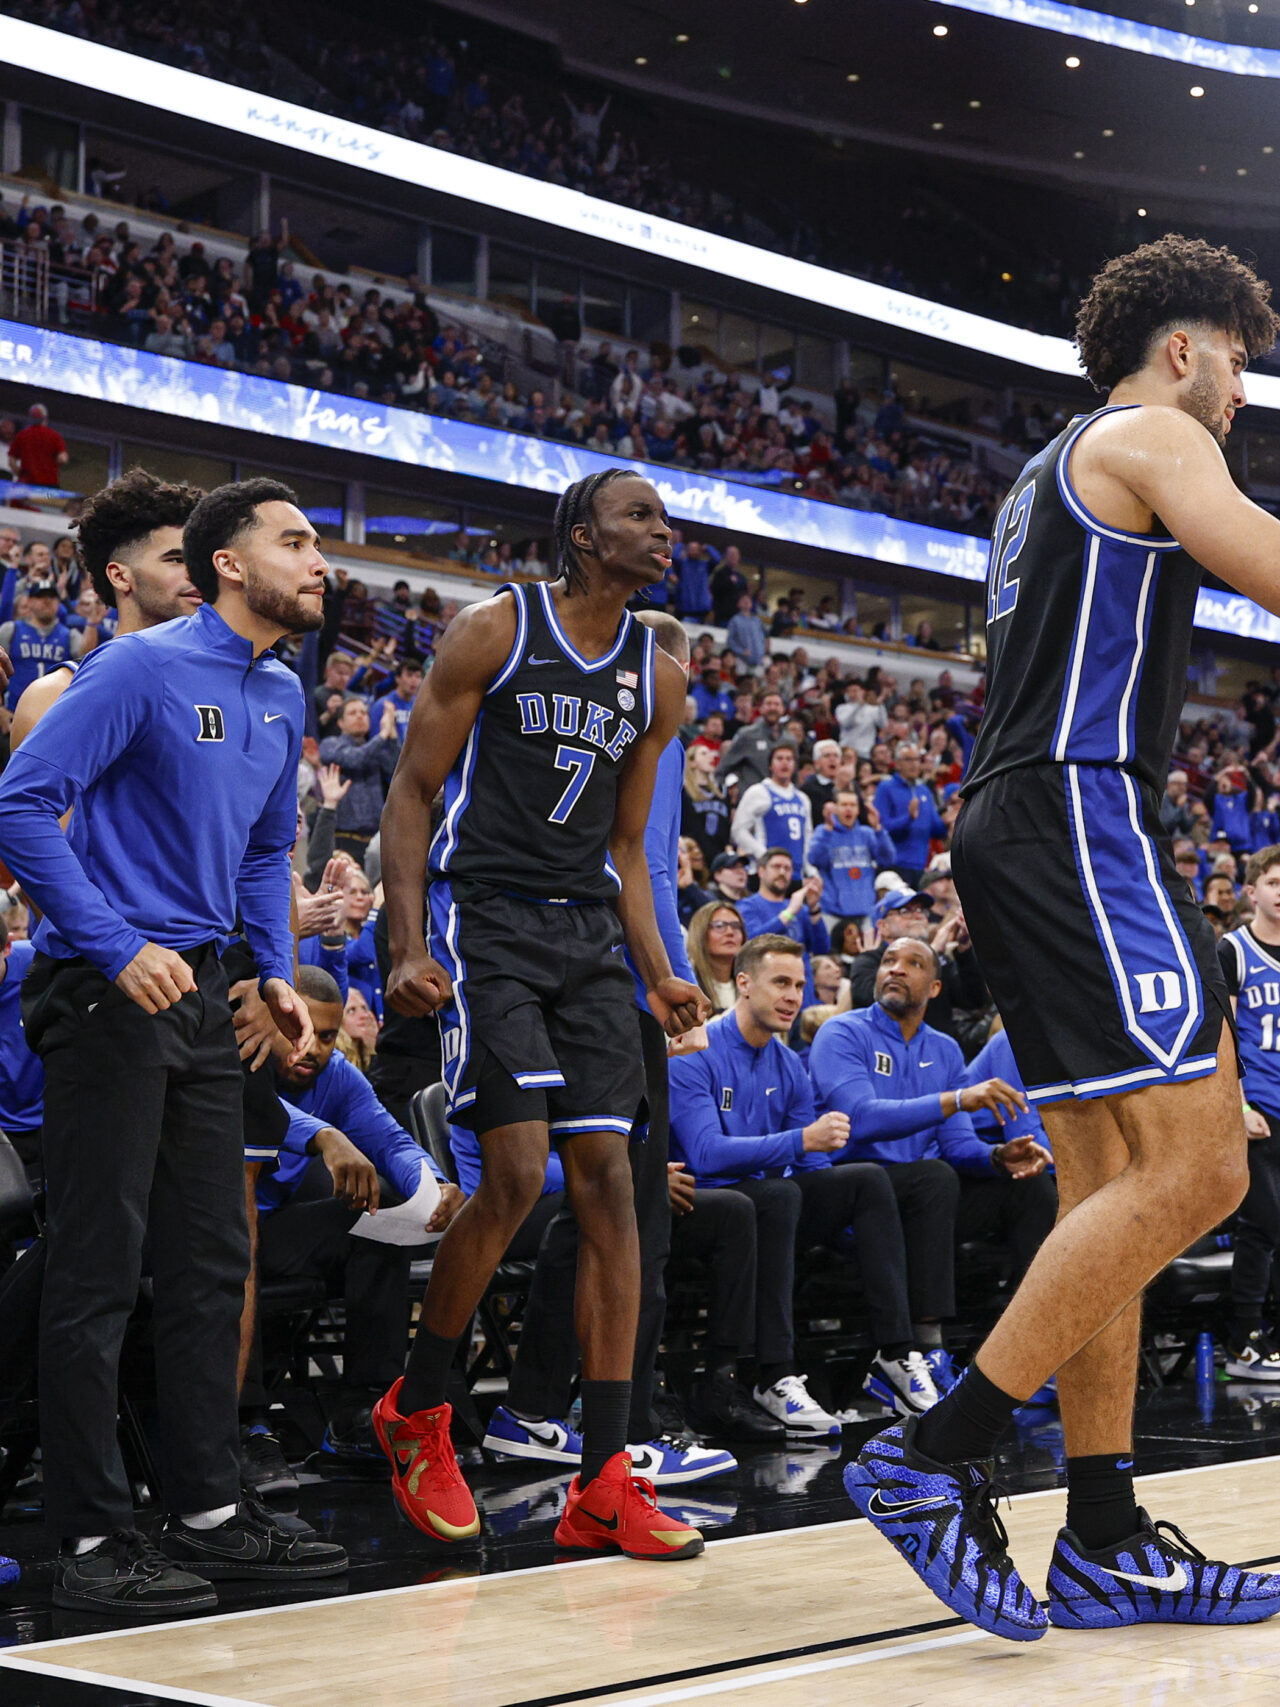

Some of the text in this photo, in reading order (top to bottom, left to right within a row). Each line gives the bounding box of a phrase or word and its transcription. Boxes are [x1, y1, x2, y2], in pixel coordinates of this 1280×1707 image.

[300, 390, 391, 445] fans
[987, 478, 1036, 628] 12
[20, 641, 65, 661] DUKE
[516, 692, 638, 762] DUKE
[547, 744, 597, 824] 7
[787, 816, 801, 841] 9
[1132, 970, 1183, 1014] D
